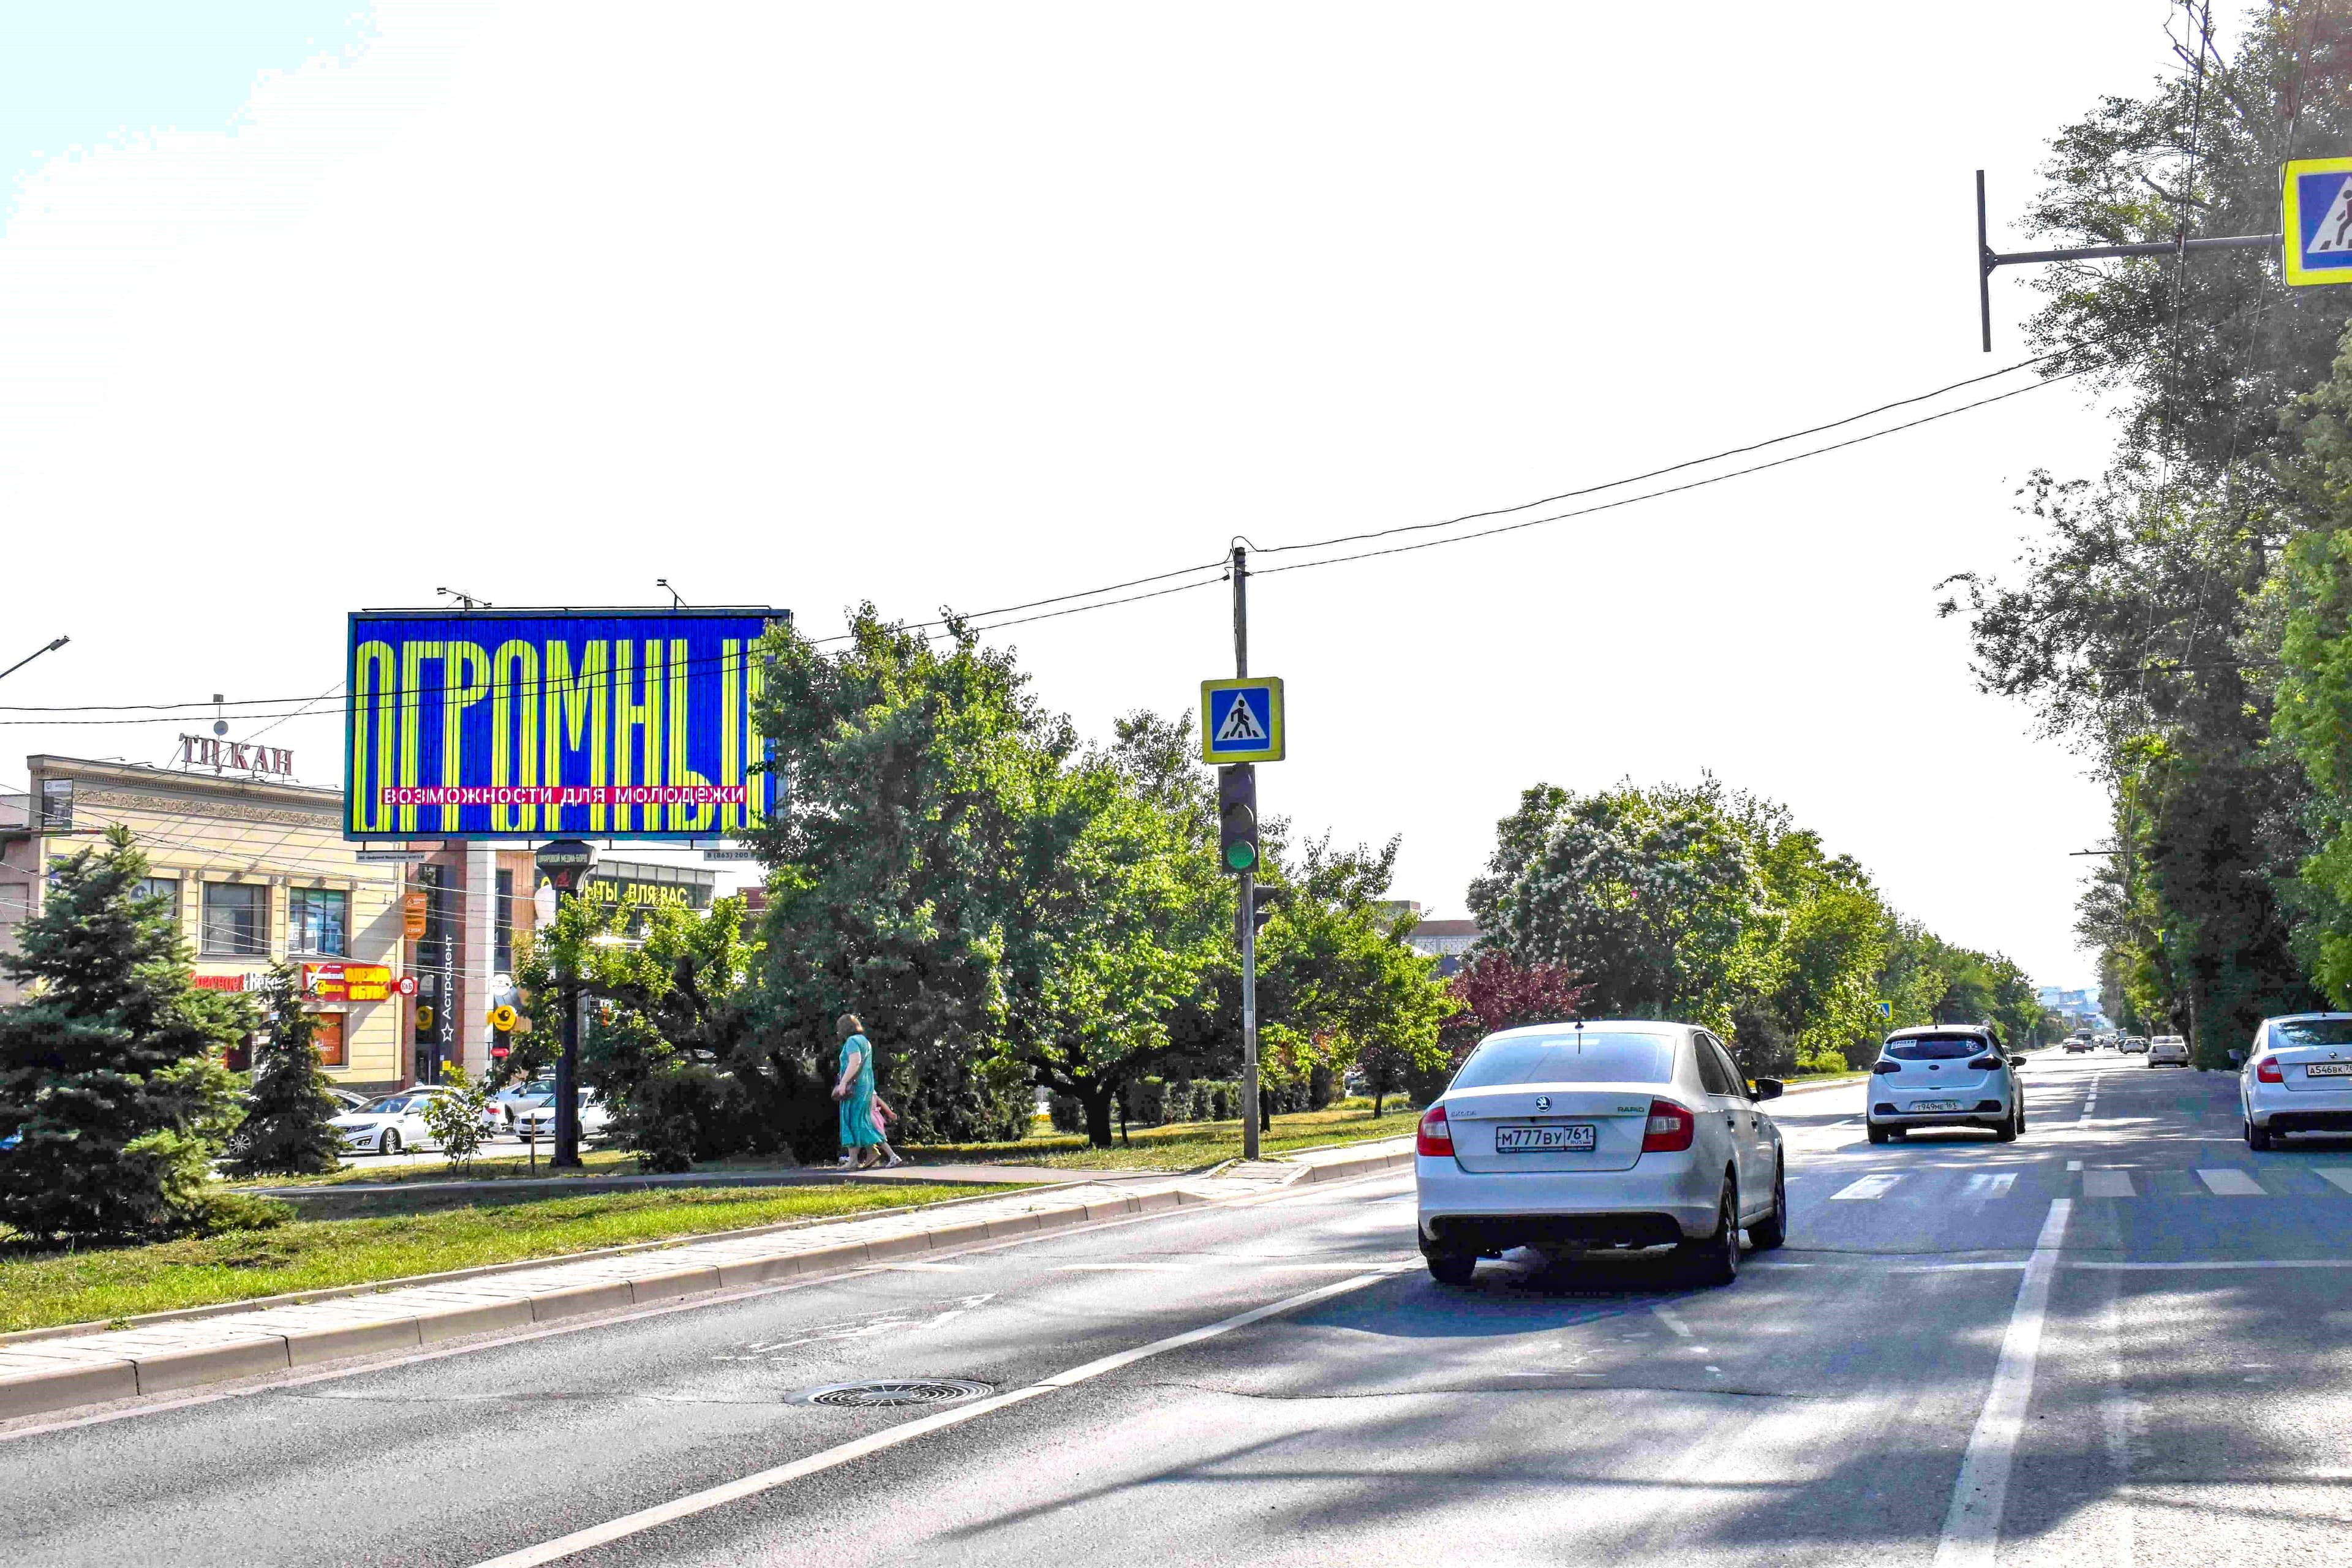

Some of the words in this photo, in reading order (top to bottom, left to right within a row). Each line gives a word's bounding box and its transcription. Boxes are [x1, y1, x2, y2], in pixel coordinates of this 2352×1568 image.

[231, 743, 293, 775] КАН
[660, 886, 687, 906] ВАС
[442, 935, 453, 1019] Астродент
[349, 985, 389, 1000] ОБУВЬ
[2310, 1066, 2342, 1074] А546ВК
[1502, 1129, 1561, 1145] М777ВУ
[1566, 1128, 1589, 1140] 761
